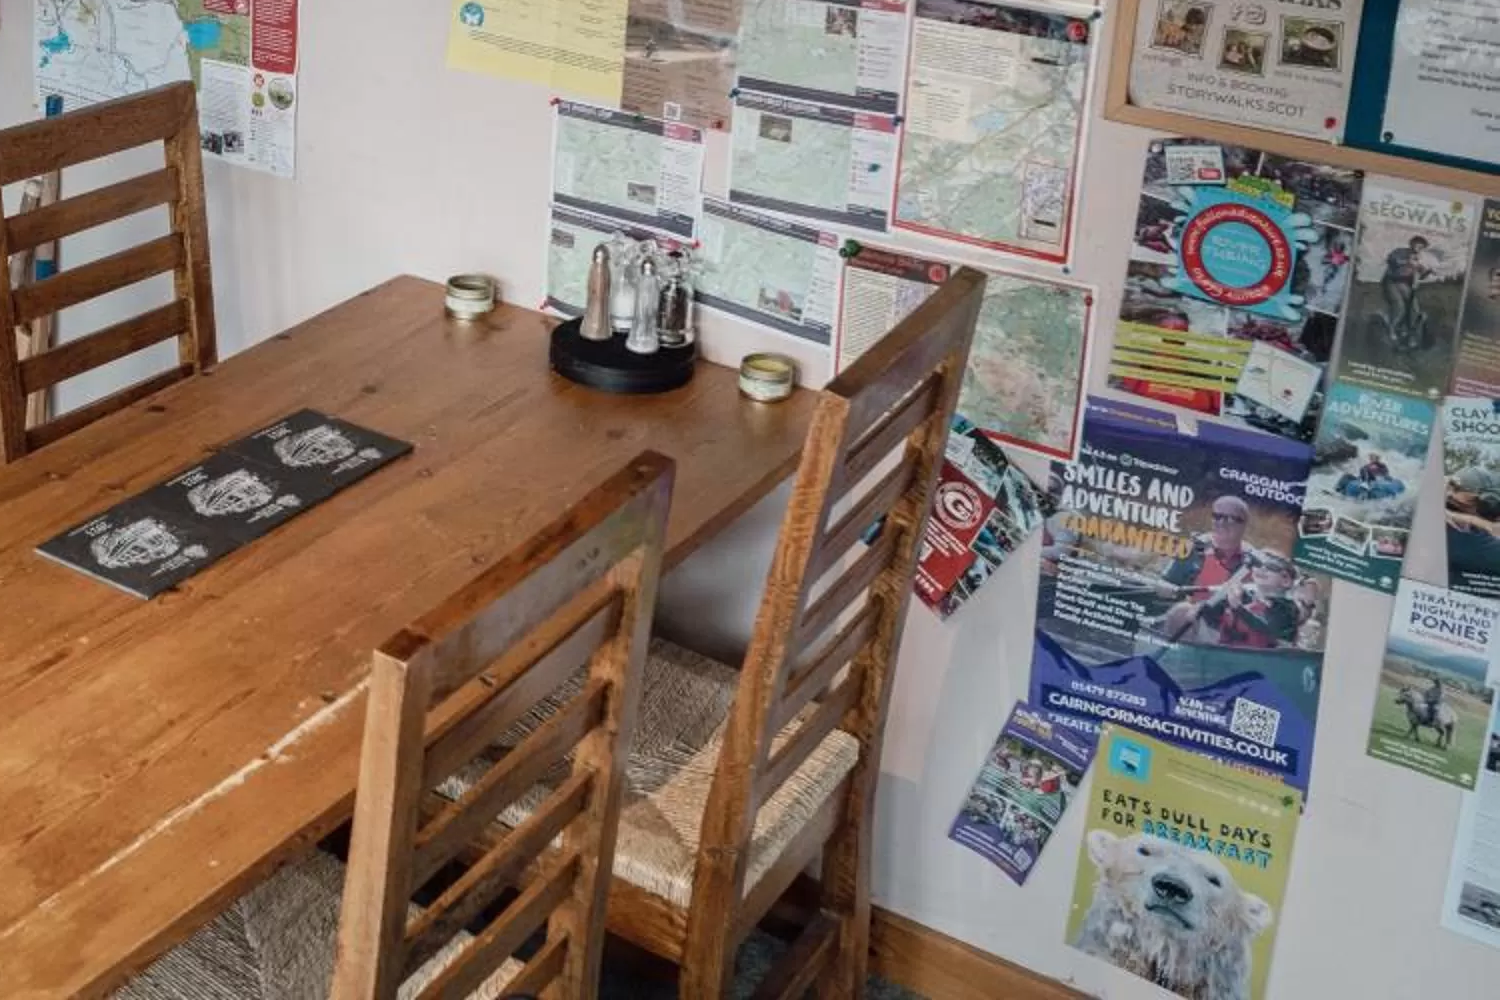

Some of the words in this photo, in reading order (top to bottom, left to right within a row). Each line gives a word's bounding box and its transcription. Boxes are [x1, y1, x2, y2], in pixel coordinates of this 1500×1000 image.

[1166, 83, 1308, 119] STORYWALKS.SCOT
[1369, 200, 1468, 233] SEGWAYS
[1328, 401, 1429, 435] ADVENTURES
[1451, 407, 1489, 419] CLAY
[1452, 420, 1500, 435] SHOO
[1063, 463, 1142, 497] SMILES
[1147, 478, 1195, 508] AND
[1219, 467, 1291, 492] CRAGGAN
[1245, 484, 1305, 506] OUTDOO
[1061, 485, 1183, 533] ADVENTURE
[1410, 611, 1489, 645] PONIES
[1412, 601, 1492, 629] HIGHLAND
[1048, 692, 1289, 767] CAIRNGORMSACTIVITIES.CO.UK
[1102, 788, 1152, 816] EATS
[1161, 807, 1210, 833] DULL
[1221, 823, 1273, 849] DAYS
[1102, 807, 1137, 830] FOR
[1141, 818, 1273, 870] BREAKFAST
